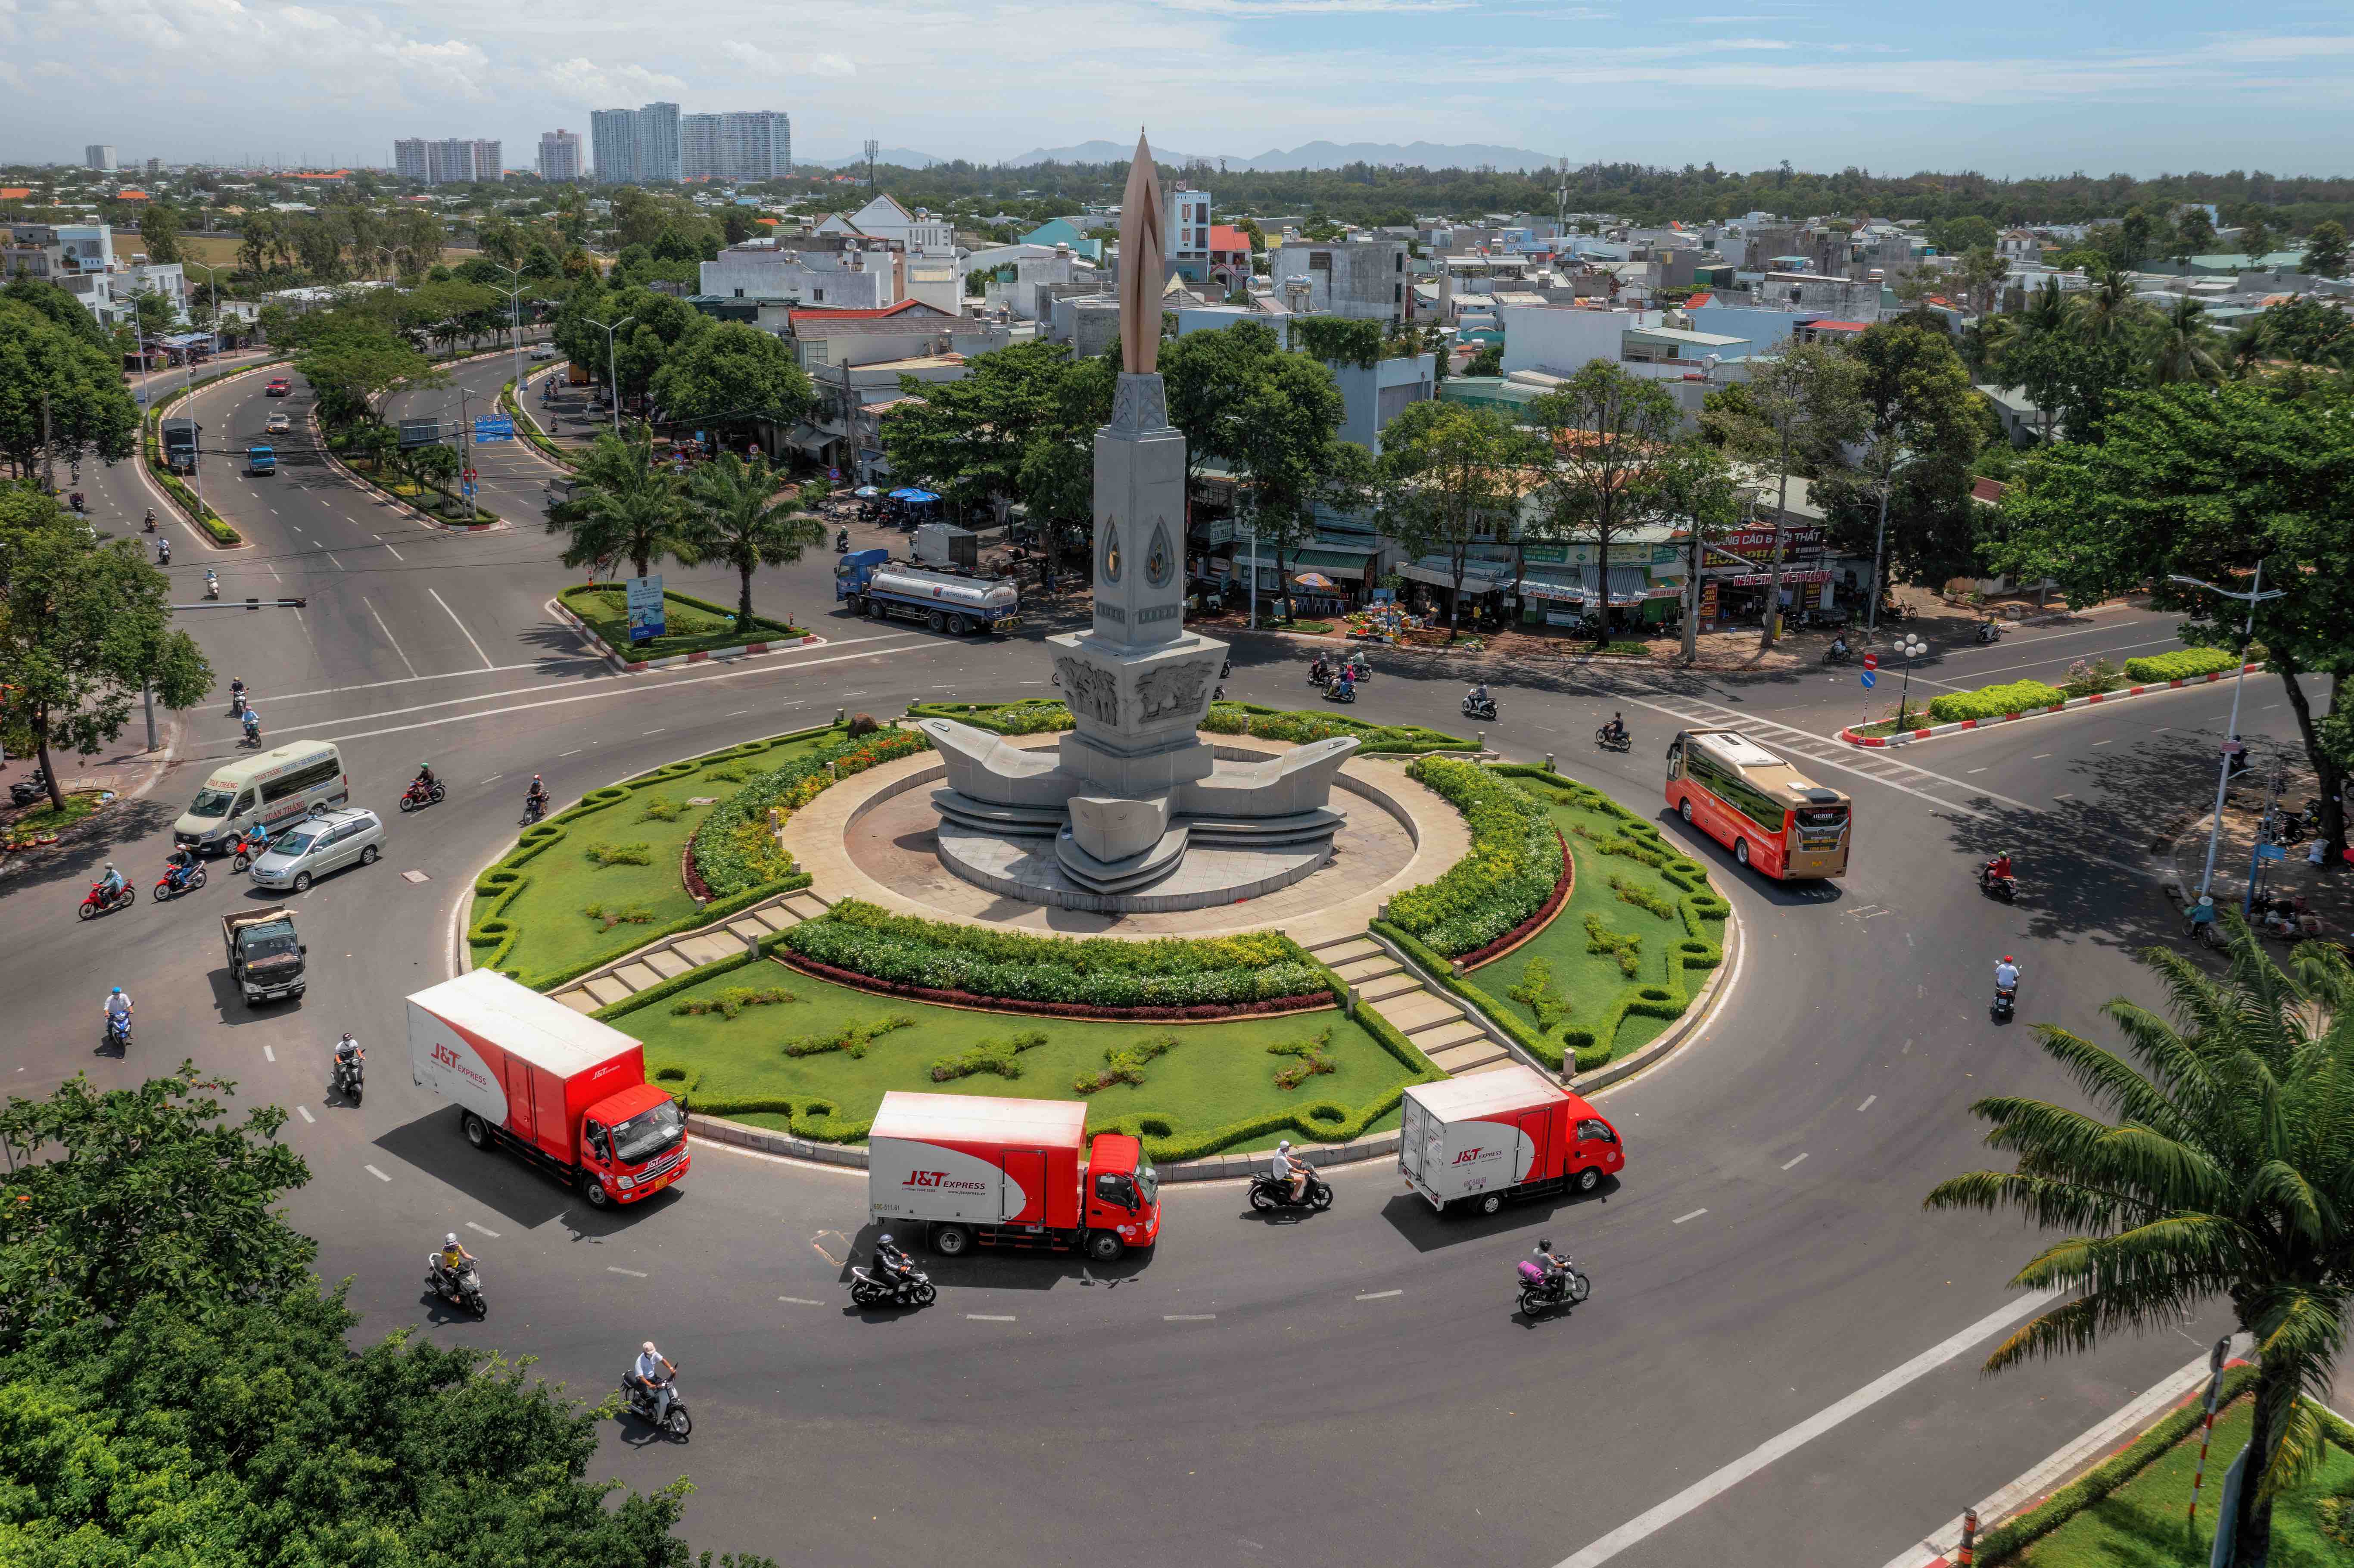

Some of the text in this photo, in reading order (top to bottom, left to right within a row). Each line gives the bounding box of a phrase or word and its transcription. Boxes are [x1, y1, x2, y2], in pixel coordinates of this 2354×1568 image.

[1742, 533, 1763, 544] CÁO
[1794, 528, 1821, 542] THẤT
[943, 590, 975, 600] PETROLIMEX
[265, 809, 283, 821] TOÀN
[283, 800, 305, 814] THẮNG
[430, 1042, 462, 1069] J&T
[458, 1064, 487, 1085] EXPRESS
[1451, 1146, 1484, 1164] J&T
[1478, 1150, 1502, 1159] EXPRESS
[902, 1170, 986, 1189] J&T EXPRESS
